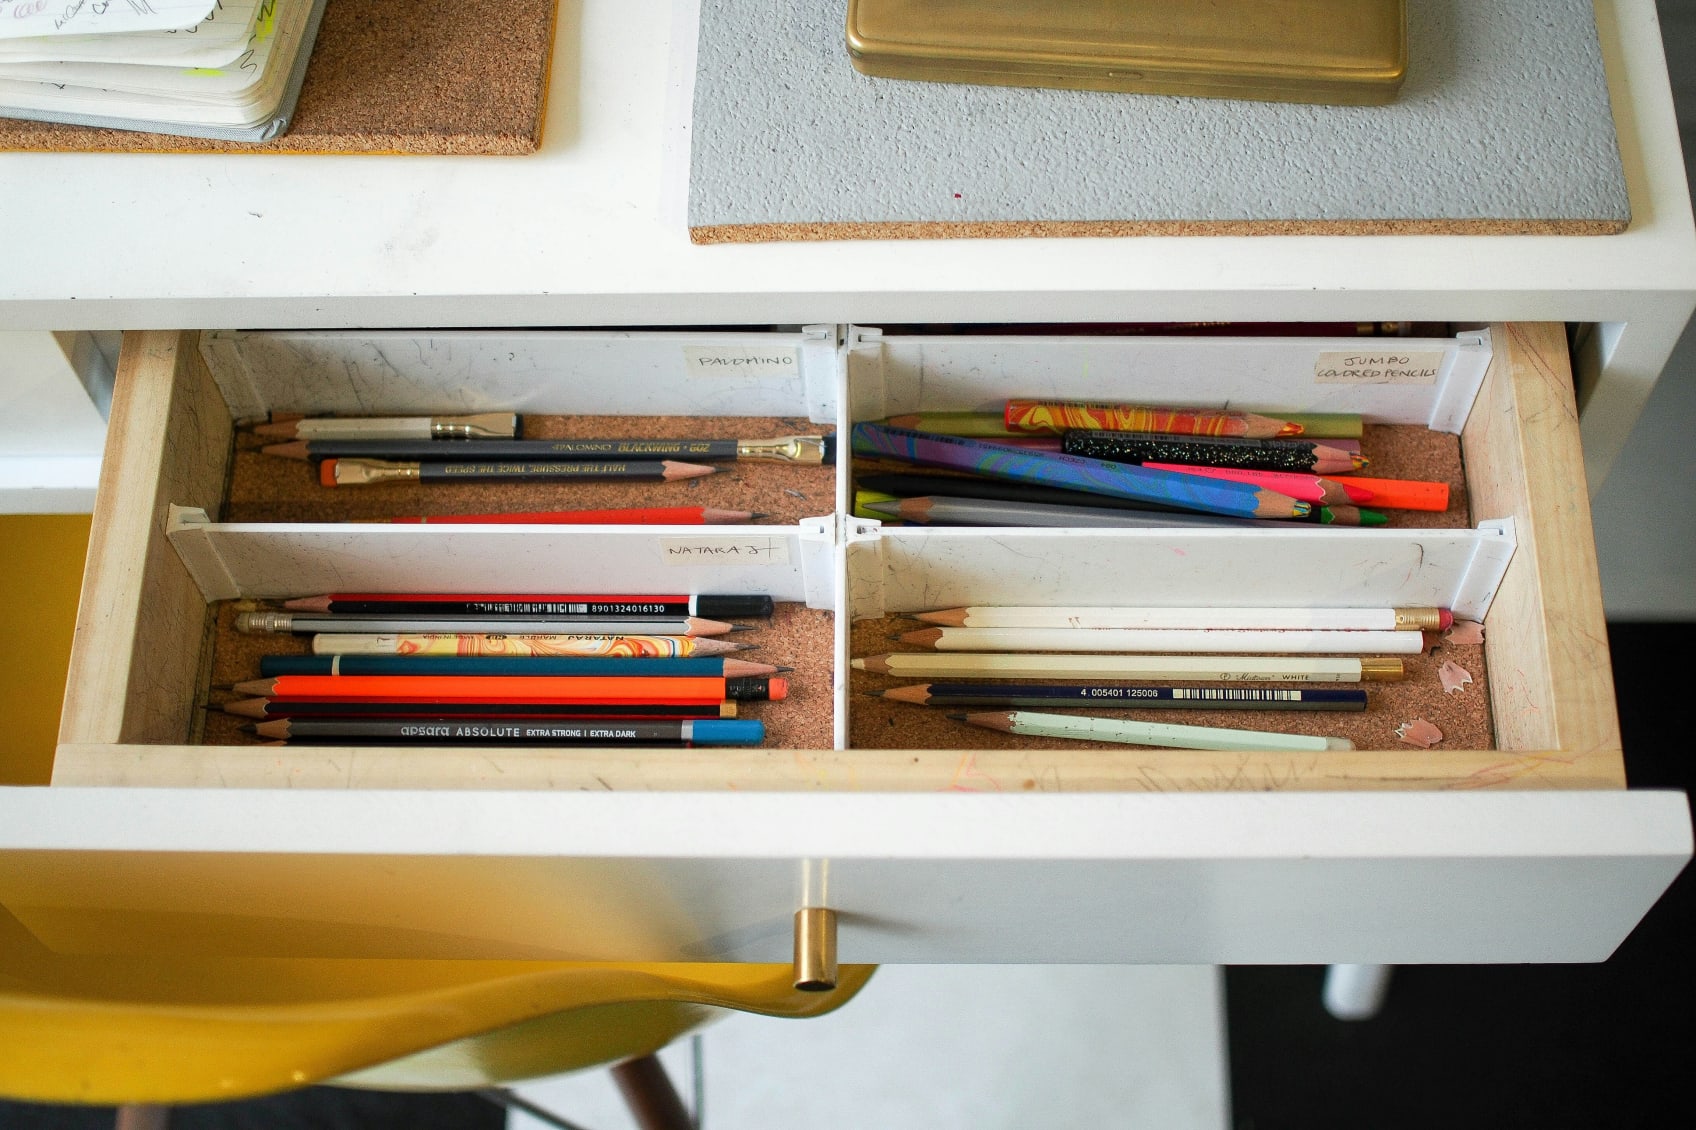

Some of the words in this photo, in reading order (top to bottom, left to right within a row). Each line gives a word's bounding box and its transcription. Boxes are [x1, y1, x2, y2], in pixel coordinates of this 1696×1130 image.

[698, 356, 793, 367] PALOMINO
[1344, 356, 1410, 366] JUMBO
[617, 442, 680, 452] BLACKWING
[591, 604, 665, 613] 8901324016130
[1091, 688, 1123, 697] 005401
[1126, 689, 1159, 698] 125006
[401, 726, 449, 737] apsara
[456, 727, 520, 738] ABSOLUTE
[526, 728, 550, 738] EXTRA
[551, 729, 581, 738] STRONG
[589, 729, 615, 738] EXTRA
[615, 729, 636, 738] DARK
